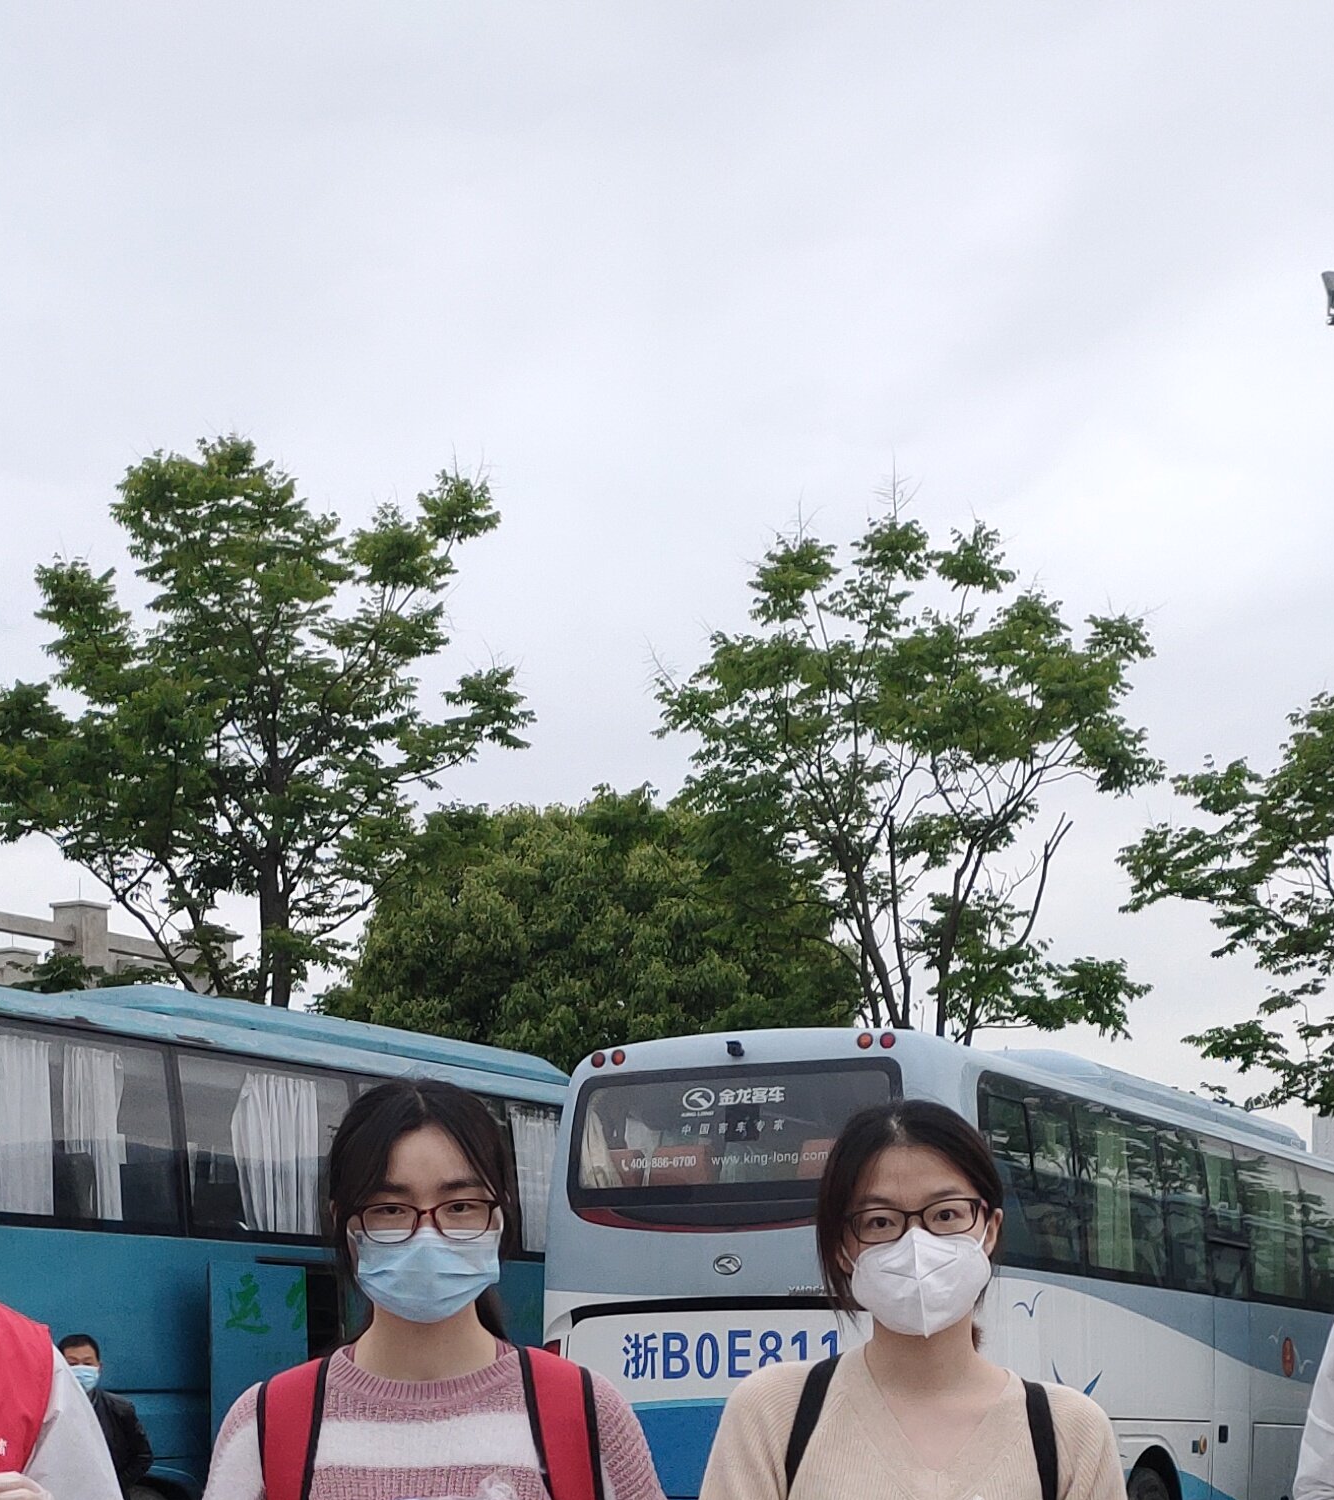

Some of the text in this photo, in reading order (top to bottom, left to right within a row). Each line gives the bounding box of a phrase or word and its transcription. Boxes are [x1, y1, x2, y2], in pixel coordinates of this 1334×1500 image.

[718, 1086, 785, 1106] 金龙客车
[681, 1119, 785, 1136] 中国客车专家
[711, 1150, 829, 1166] www.king-long.com
[622, 1329, 839, 1380] 浙B0E811
